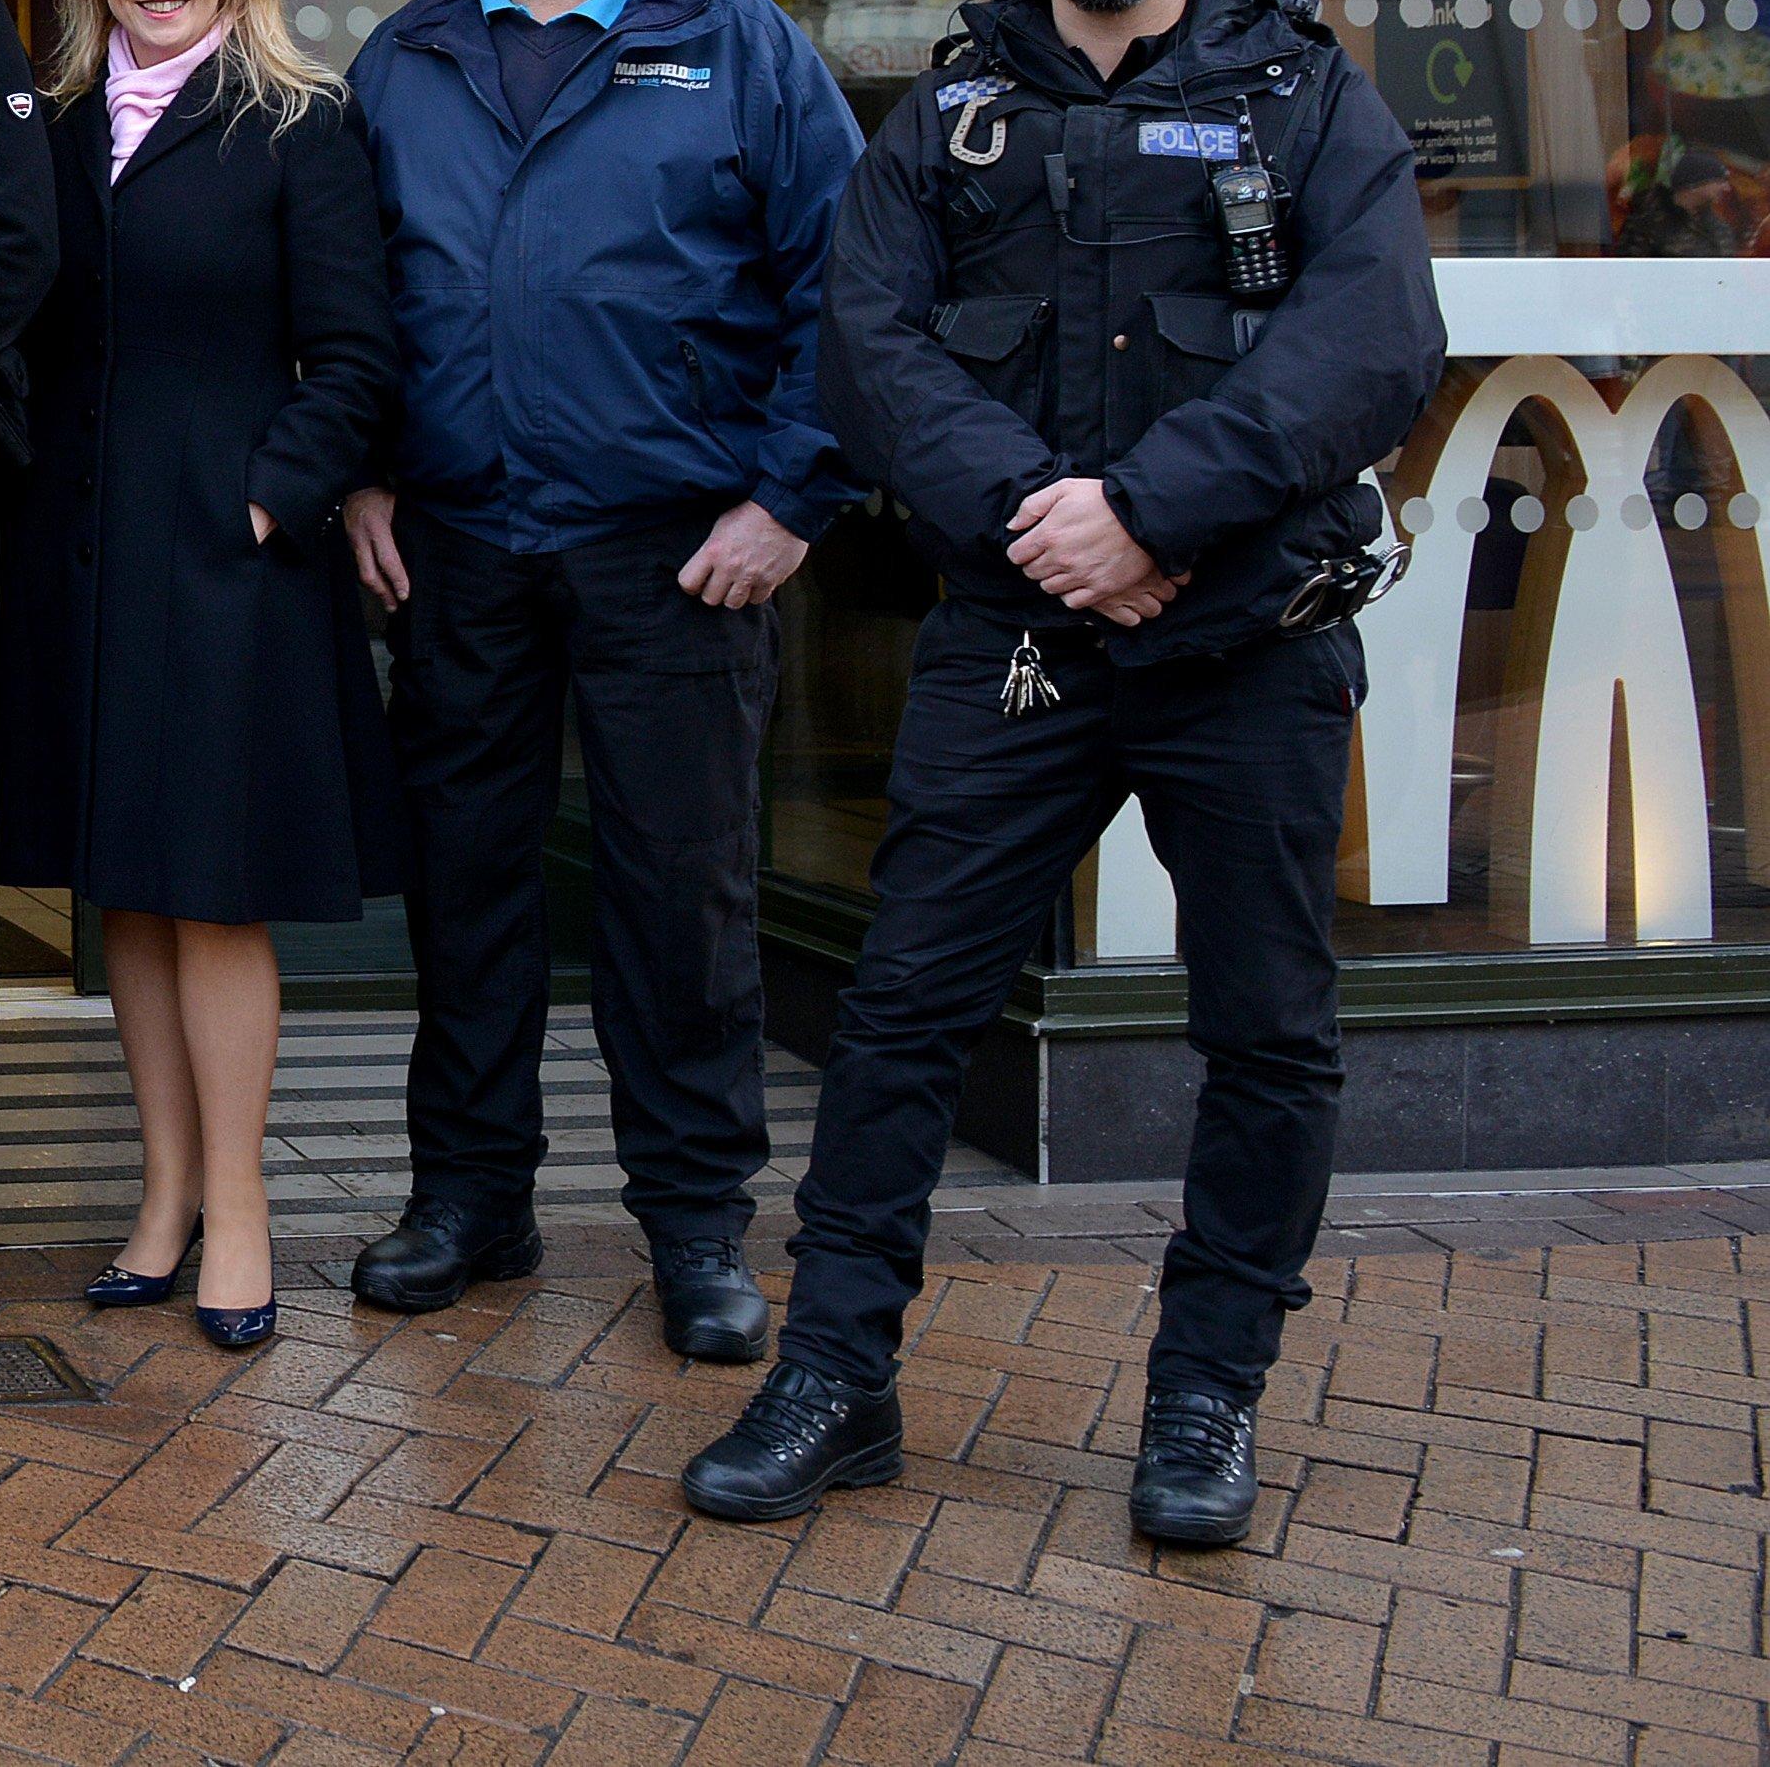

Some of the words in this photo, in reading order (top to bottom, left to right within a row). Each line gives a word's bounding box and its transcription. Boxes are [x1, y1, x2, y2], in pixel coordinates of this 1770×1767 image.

[1415, 118, 1427, 130] for
[1429, 117, 1460, 132] helping
[1474, 116, 1493, 128] with
[1143, 127, 1235, 154] POLICE
[1465, 136, 1473, 145] to
[1476, 134, 1497, 145] send
[1468, 150, 1497, 163] landfill
